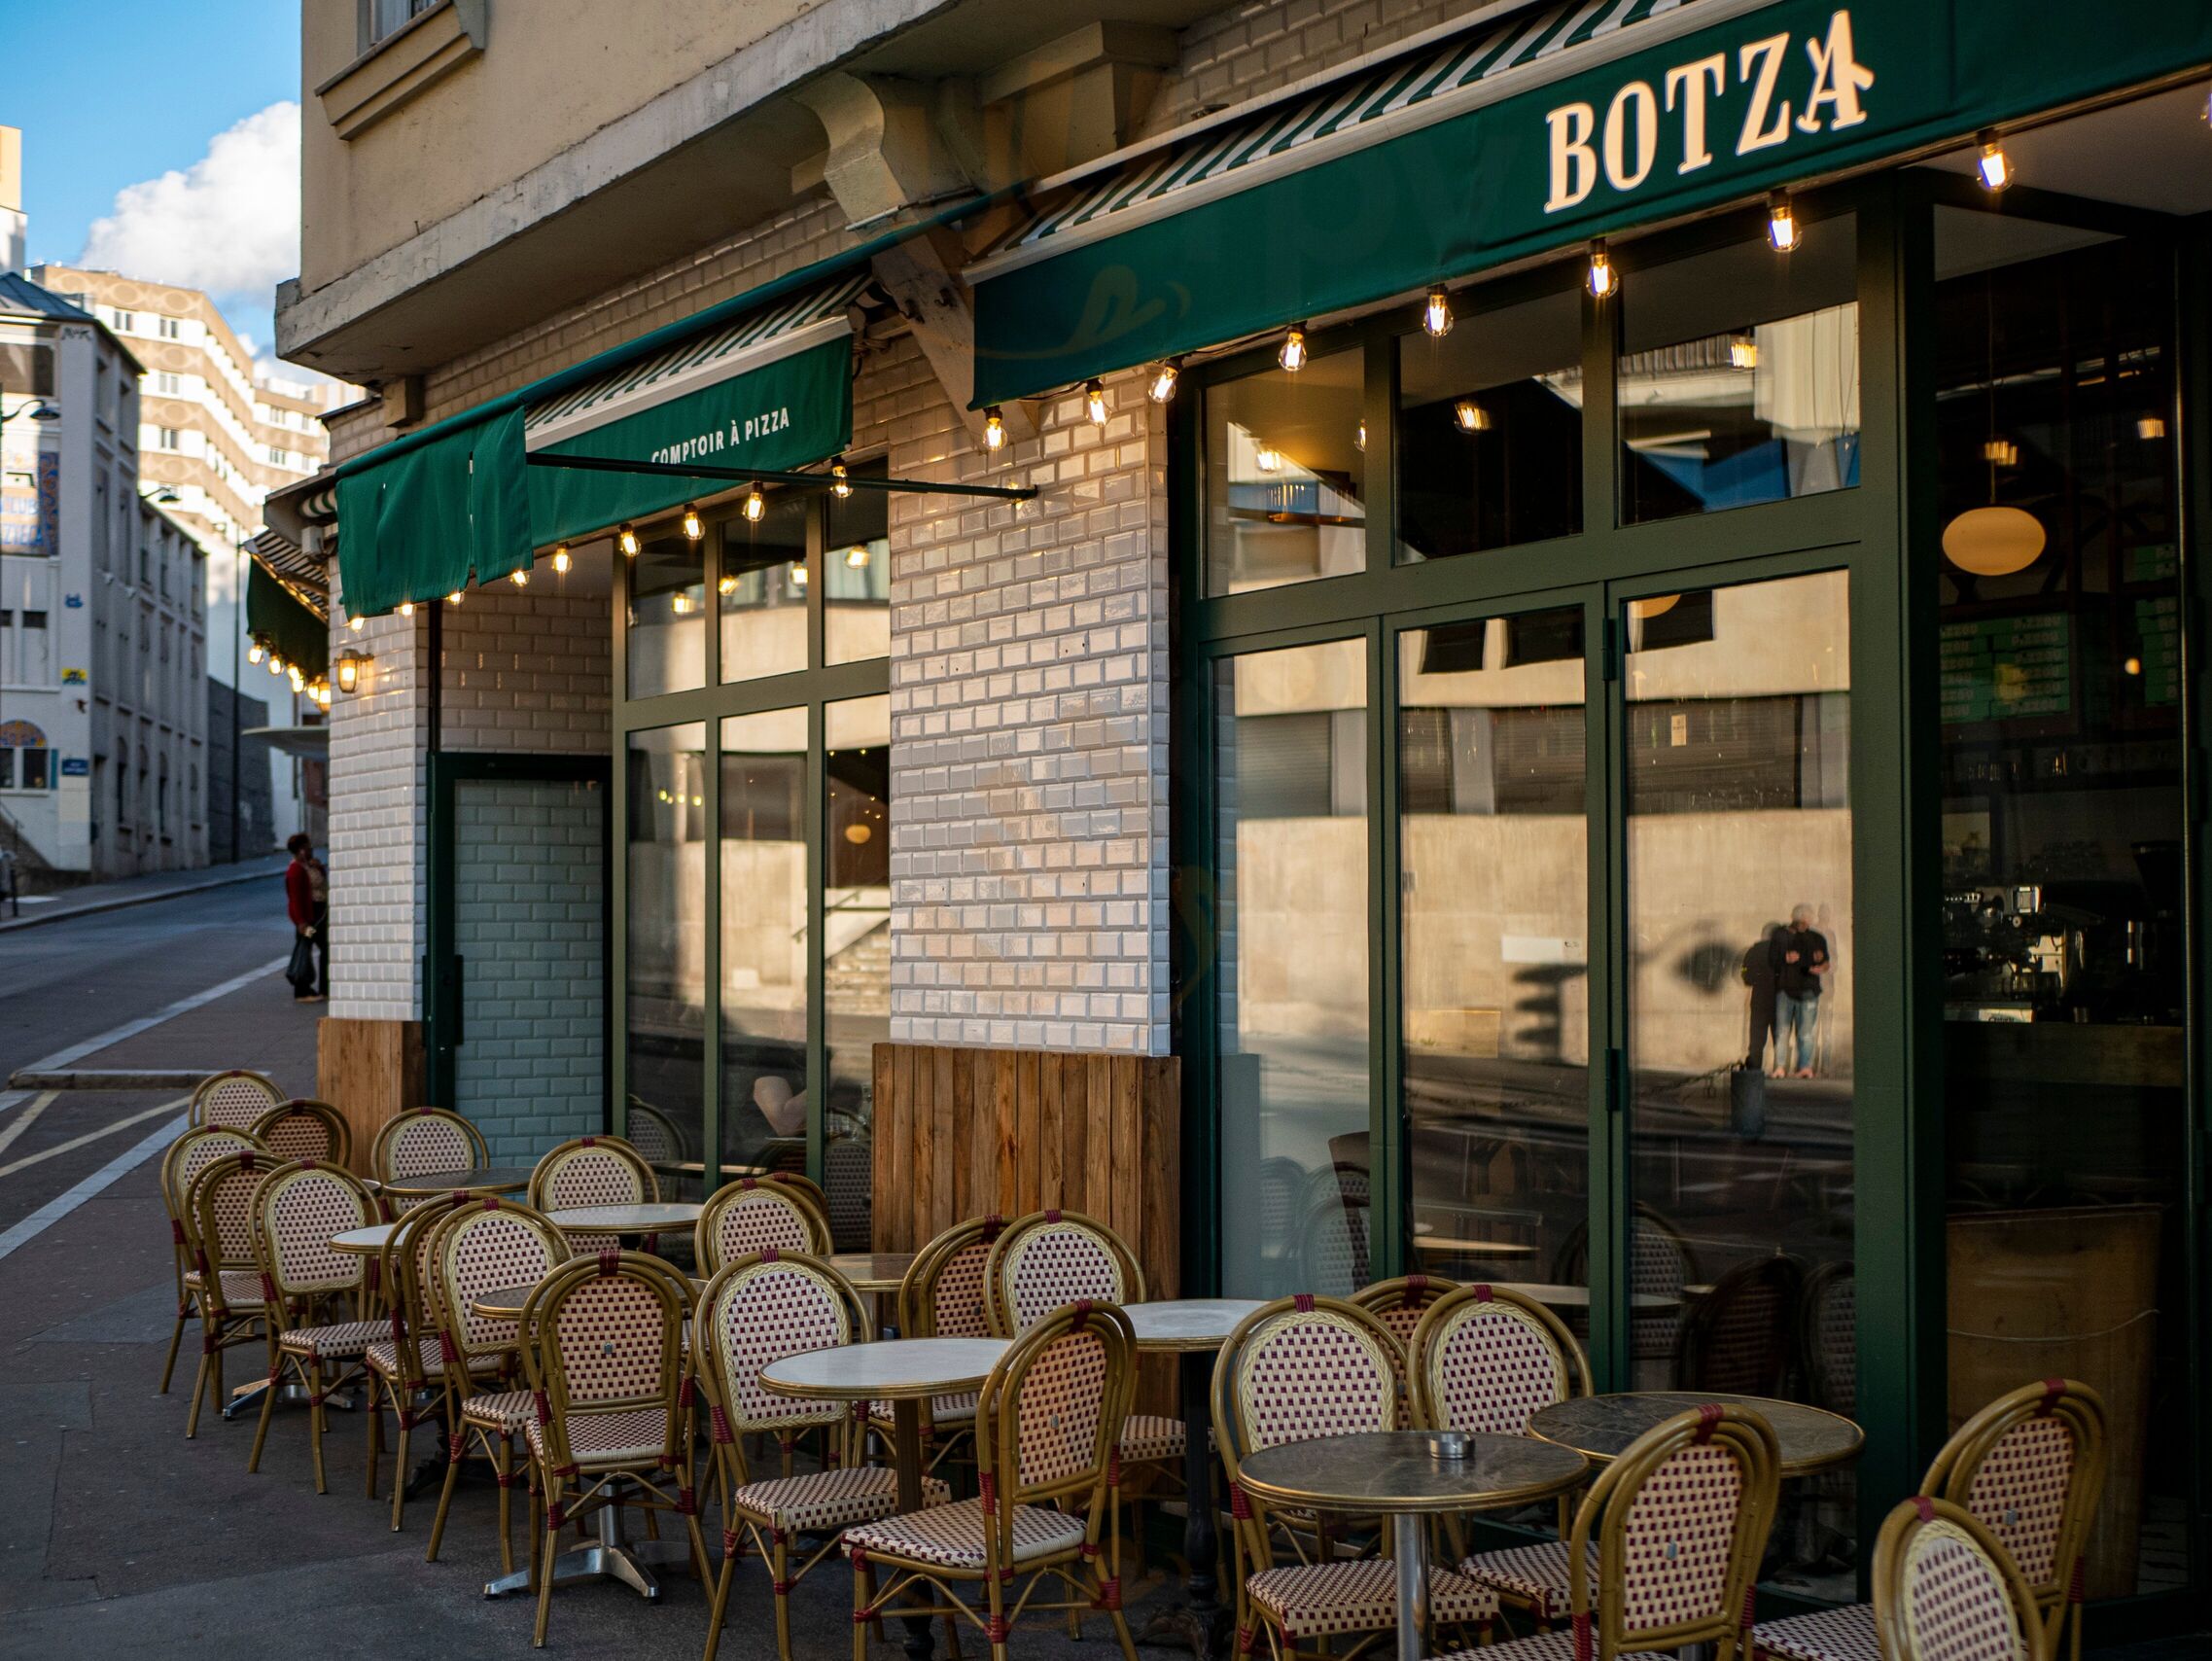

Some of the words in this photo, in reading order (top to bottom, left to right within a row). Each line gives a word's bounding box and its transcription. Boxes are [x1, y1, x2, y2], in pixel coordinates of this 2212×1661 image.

[1543, 9, 1876, 214] BOTZA
[651, 430, 724, 465] COMPTOIR
[730, 419, 740, 446] À
[745, 406, 790, 442] PIZZA
